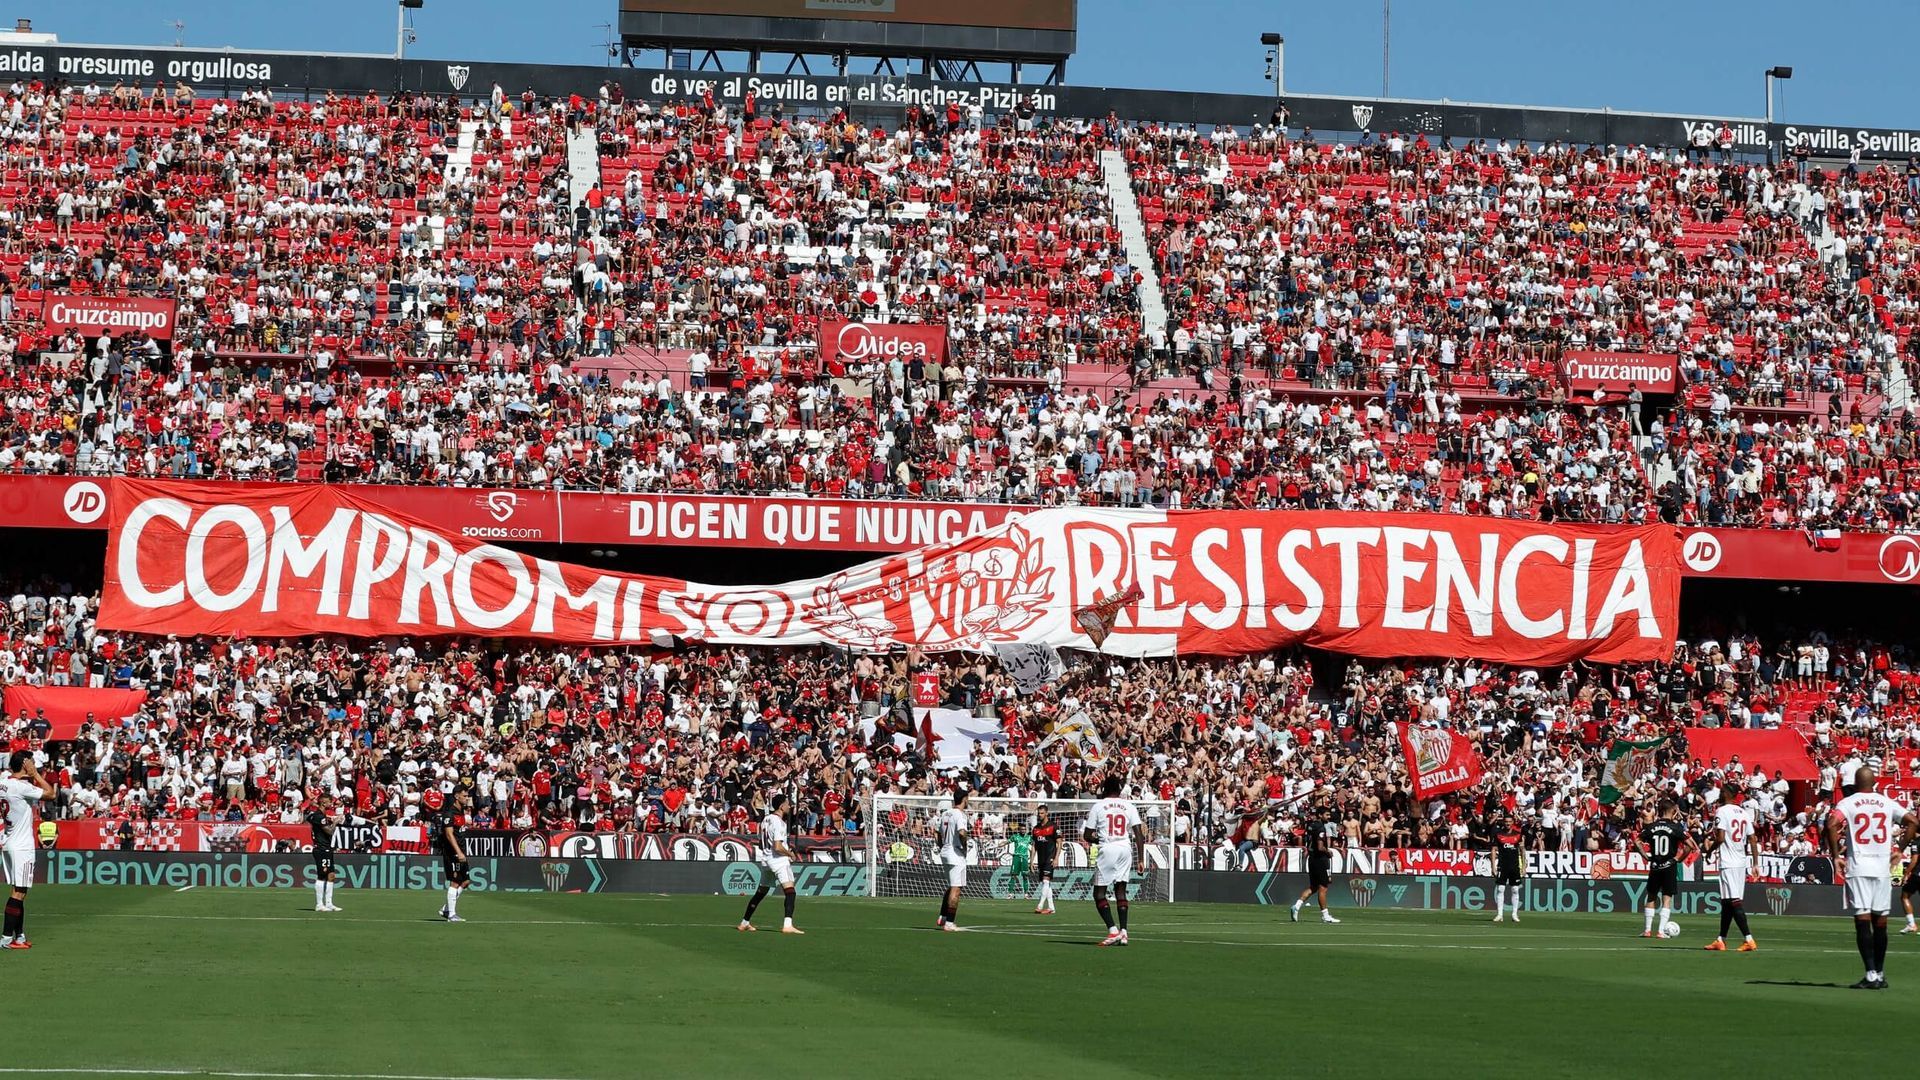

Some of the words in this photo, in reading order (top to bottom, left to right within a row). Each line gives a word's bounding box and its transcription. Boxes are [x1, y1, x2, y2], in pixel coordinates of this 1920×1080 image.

[167, 58, 272, 82] orgullosa
[651, 74, 677, 95] de
[723, 77, 741, 97] al
[748, 77, 818, 101] Sevilla
[825, 87, 849, 102] en
[857, 83, 875, 101] el
[1683, 121, 1696, 141] Y
[52, 302, 168, 330] Cruzcampo
[850, 334, 926, 356] Midea
[1567, 358, 1672, 385] Cruzcampo
[70, 491, 100, 512] JD
[462, 526, 542, 539] SOCIOS.com
[629, 500, 748, 540] DICEN
[763, 504, 841, 546] QUE
[855, 507, 990, 545] NUNCA
[1689, 542, 1716, 562] JD
[117, 497, 796, 641] COMPROMISO
[1066, 522, 1663, 641] RESISTENCIA
[1420, 766, 1469, 790] SEVILLA
[1106, 814, 1126, 837] 19
[1731, 819, 1747, 842] 20
[1854, 813, 1887, 845] 23
[1653, 835, 1670, 857] 10
[728, 882, 756, 890] SPORTS
[729, 869, 755, 882] EA
[1415, 876, 1486, 911] The
[1588, 880, 1614, 913] is
